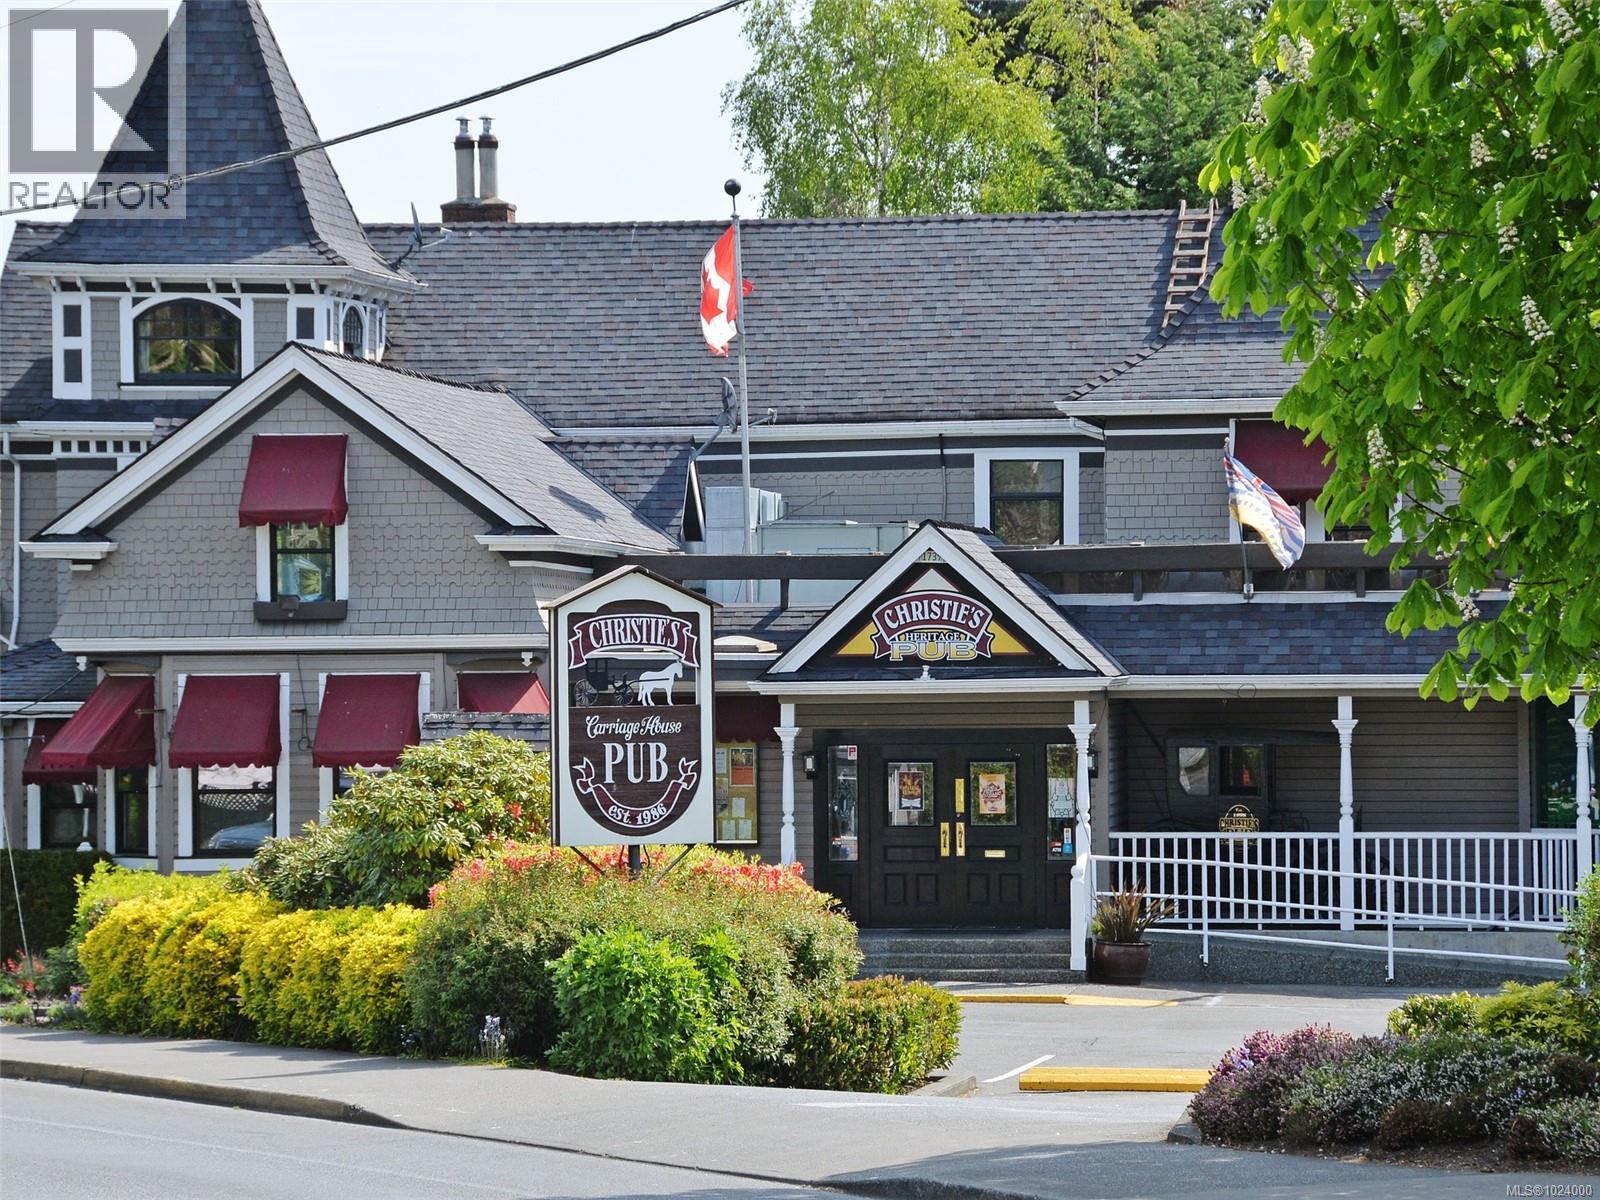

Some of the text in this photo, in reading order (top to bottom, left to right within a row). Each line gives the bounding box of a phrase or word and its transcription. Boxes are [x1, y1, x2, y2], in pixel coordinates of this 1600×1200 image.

[884, 599, 984, 629] CHRISTIE'S
[588, 616, 680, 647] CHRISTIE'S
[906, 632, 961, 641] HERITAGE
[890, 641, 976, 661] PUB
[585, 715, 682, 741] Carriage House
[603, 742, 669, 784] PUB
[636, 802, 668, 825] 1986
